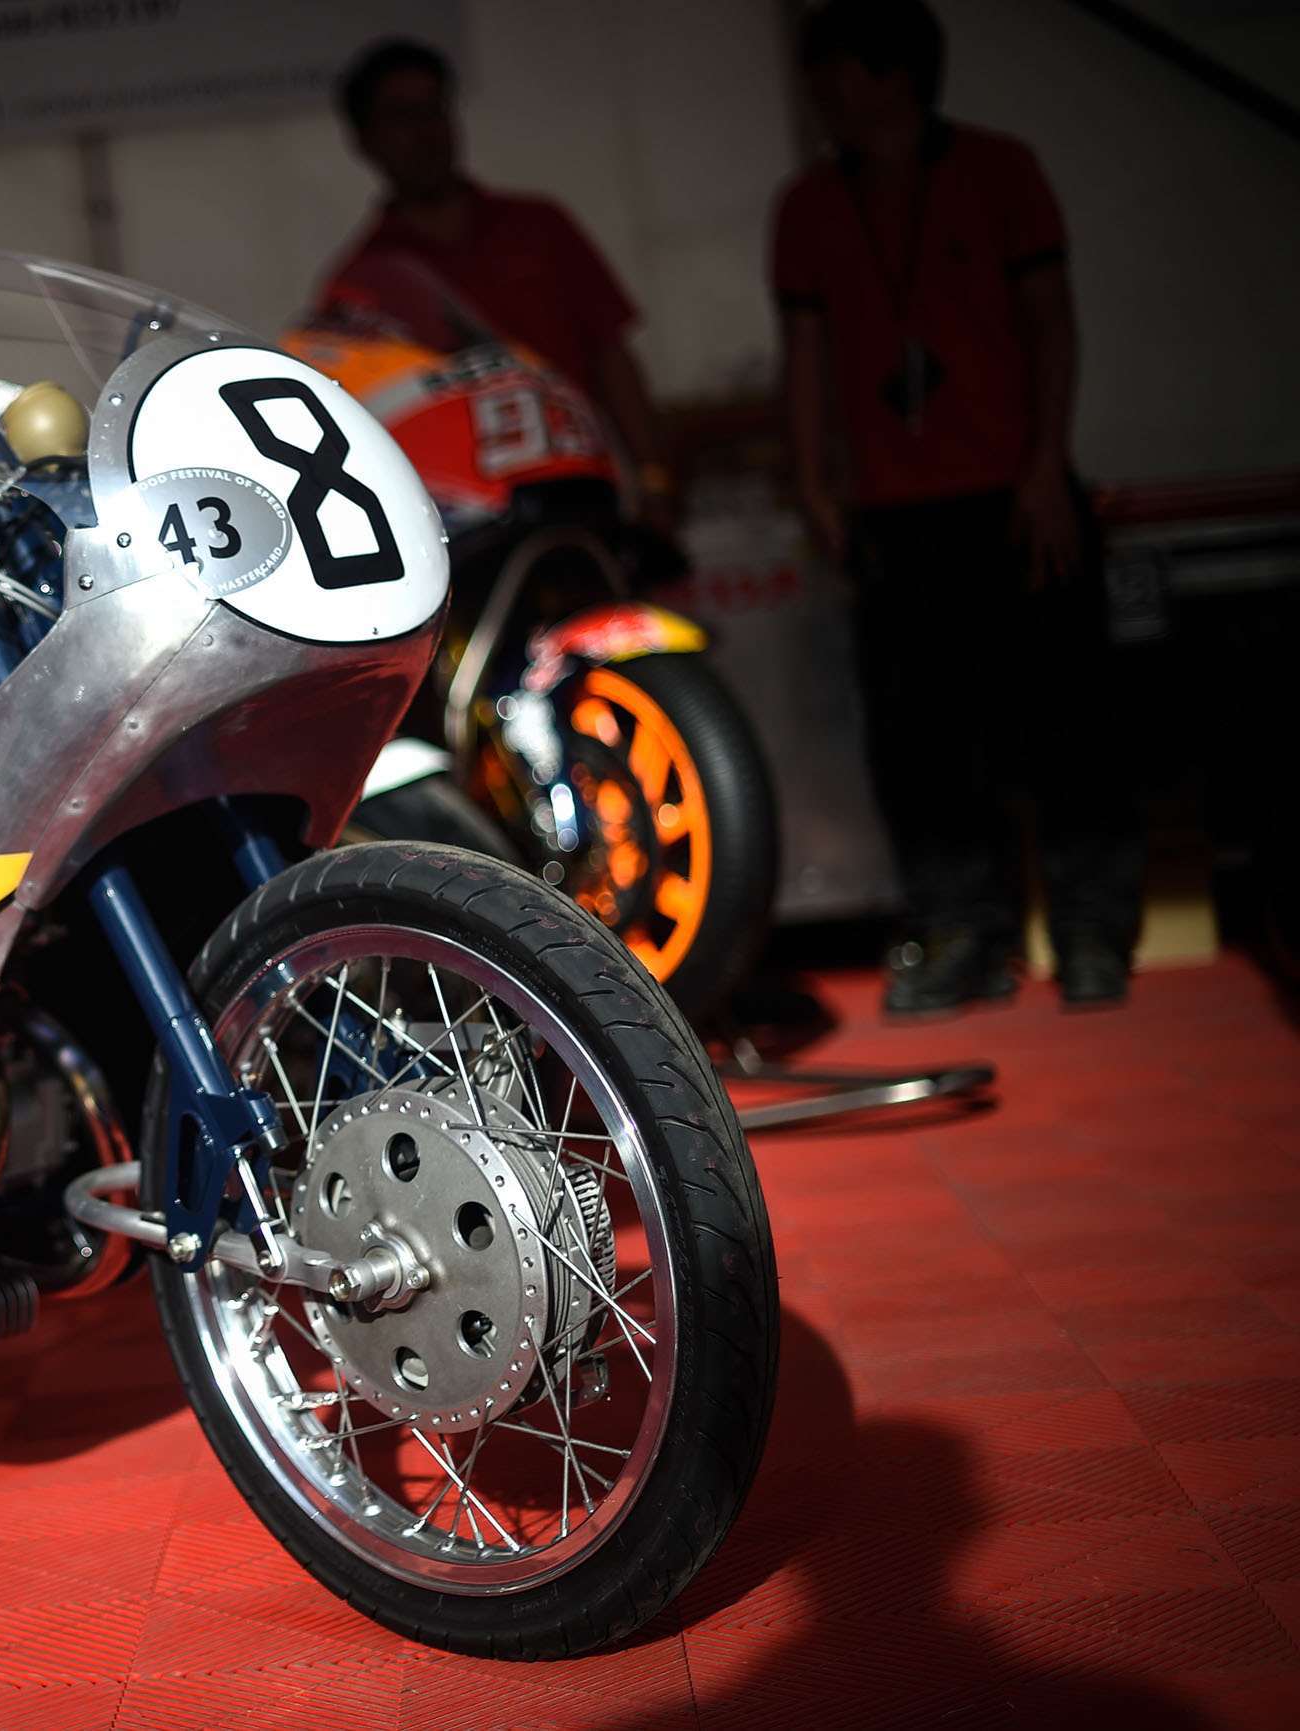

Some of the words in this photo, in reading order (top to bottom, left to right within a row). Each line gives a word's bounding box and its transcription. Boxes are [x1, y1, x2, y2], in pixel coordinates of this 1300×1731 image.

[171, 469, 231, 481] FESTIVAL
[236, 477, 252, 487] OF
[256, 487, 286, 519] SPEED
[218, 377, 406, 591] 8
[159, 497, 242, 565] 43
[219, 548, 282, 591] MASTERCARD
